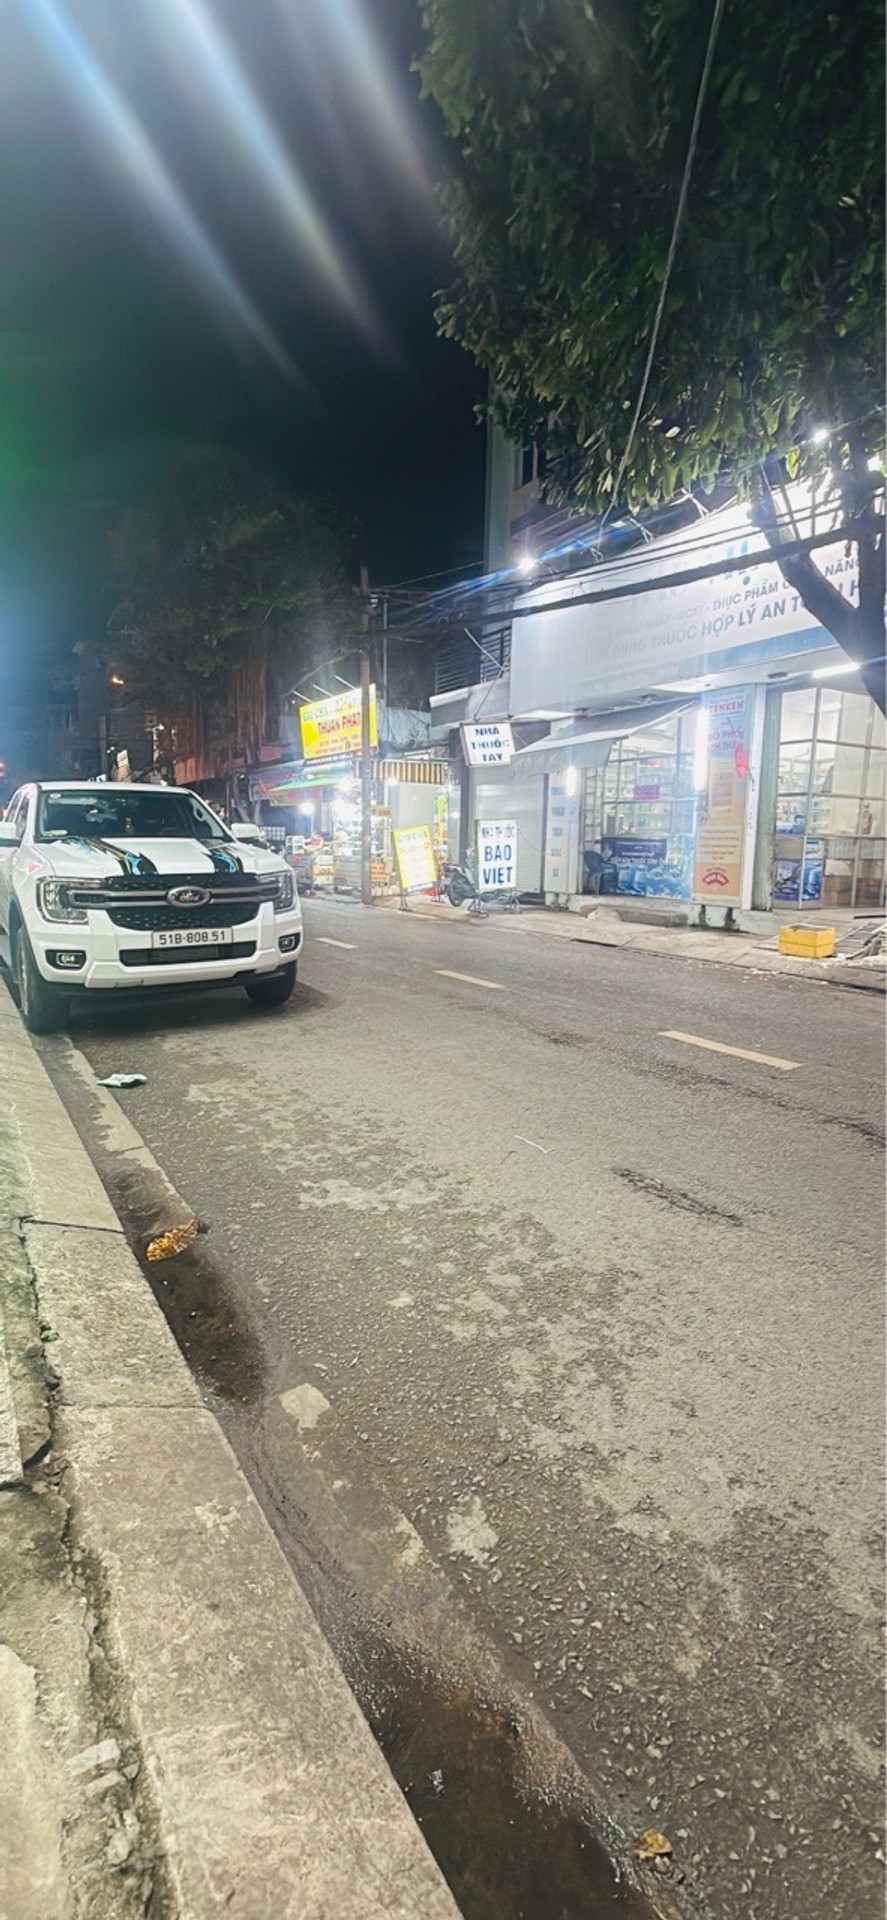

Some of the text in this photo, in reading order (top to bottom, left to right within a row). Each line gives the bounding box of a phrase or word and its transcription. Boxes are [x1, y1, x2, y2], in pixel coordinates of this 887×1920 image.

[712, 594, 741, 611] THỰC
[743, 578, 778, 601] PHẨM
[701, 614, 735, 640] HỢP
[737, 603, 757, 627] LÝ
[760, 601, 786, 622] AN
[470, 737, 510, 750] THUỐC
